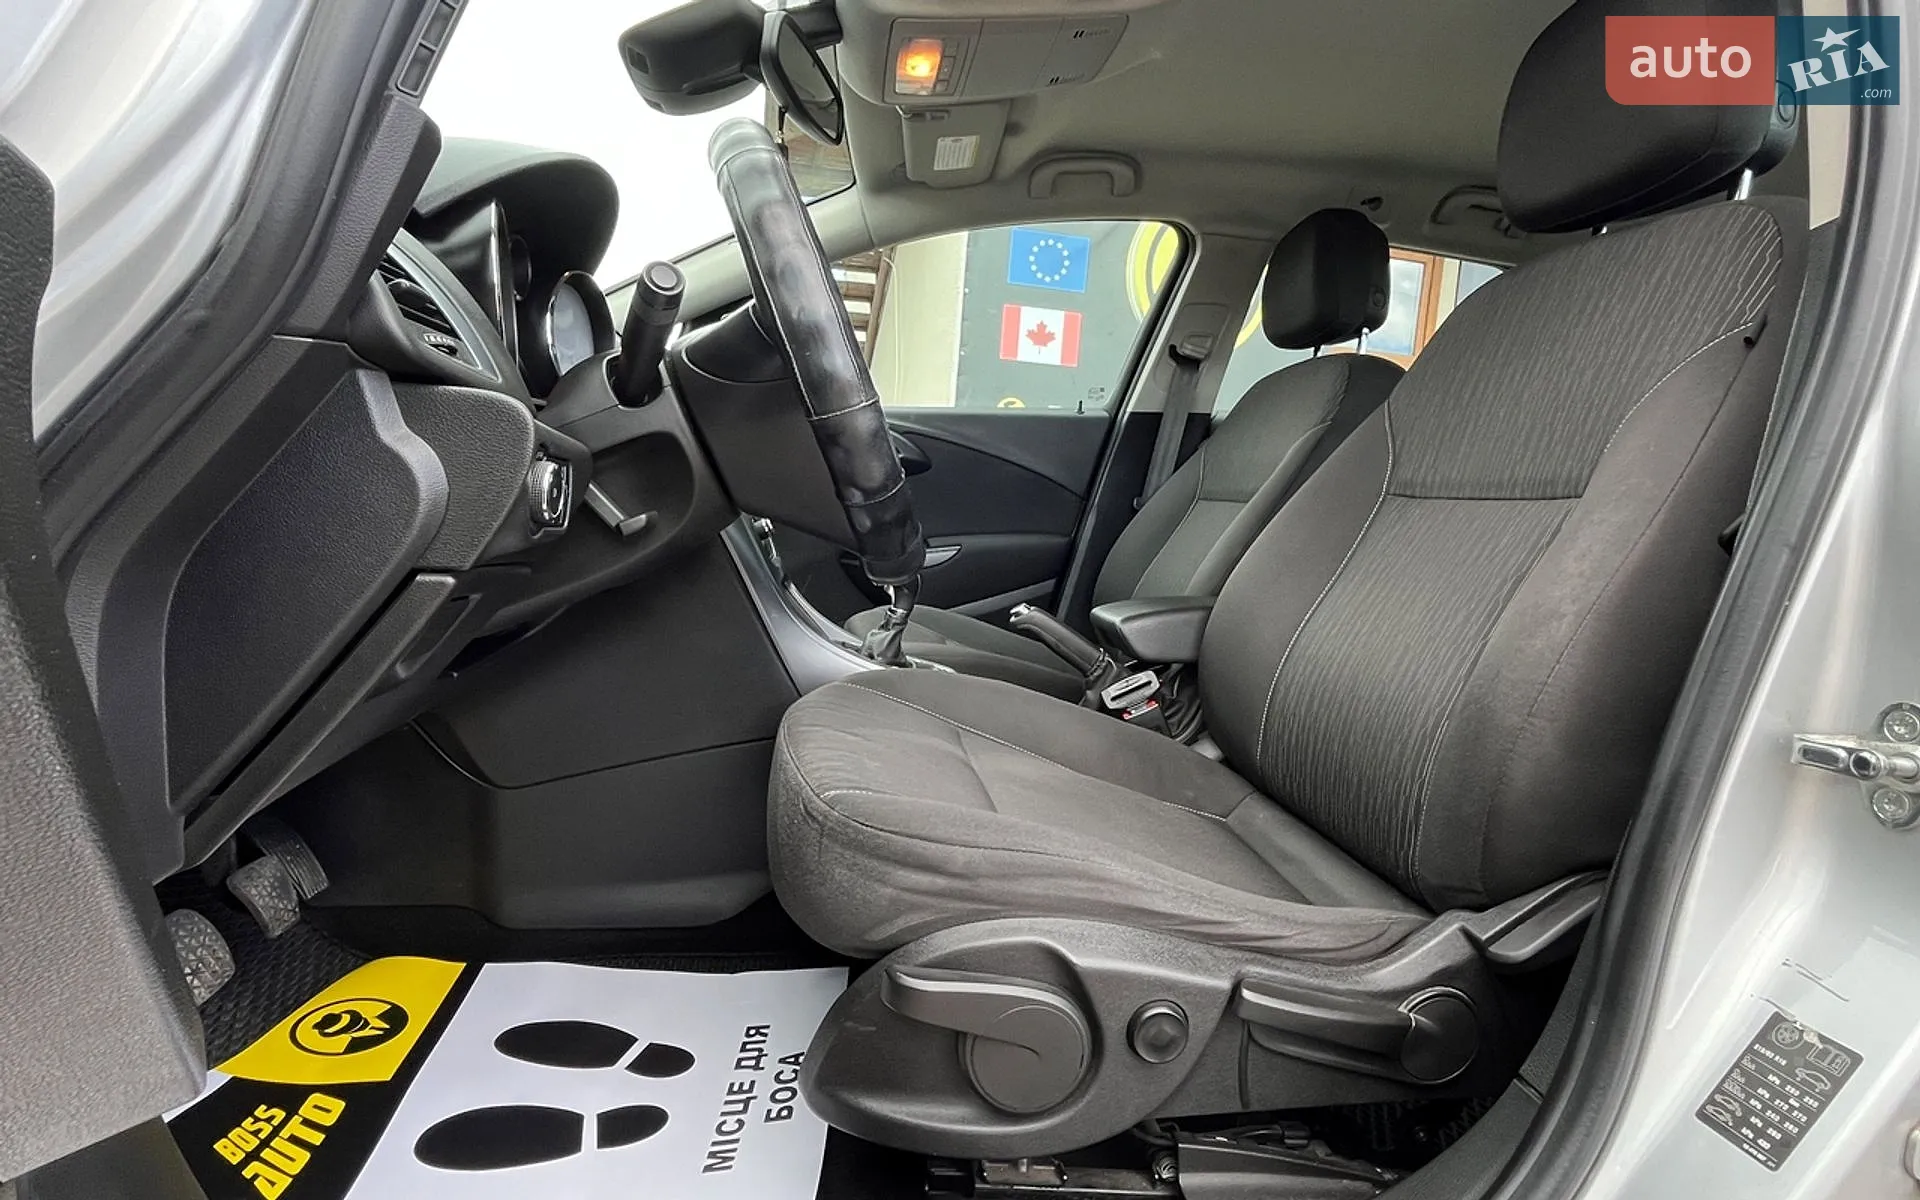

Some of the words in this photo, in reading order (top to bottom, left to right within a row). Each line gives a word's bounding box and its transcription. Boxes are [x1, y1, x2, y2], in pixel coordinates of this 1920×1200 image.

[702, 1080, 758, 1173] МІСЦЕ
[734, 1024, 770, 1071] ДЛЯ
[764, 1051, 805, 1123] БОСА
[213, 1104, 286, 1165] BOSS
[242, 1092, 346, 1200] AUTO
